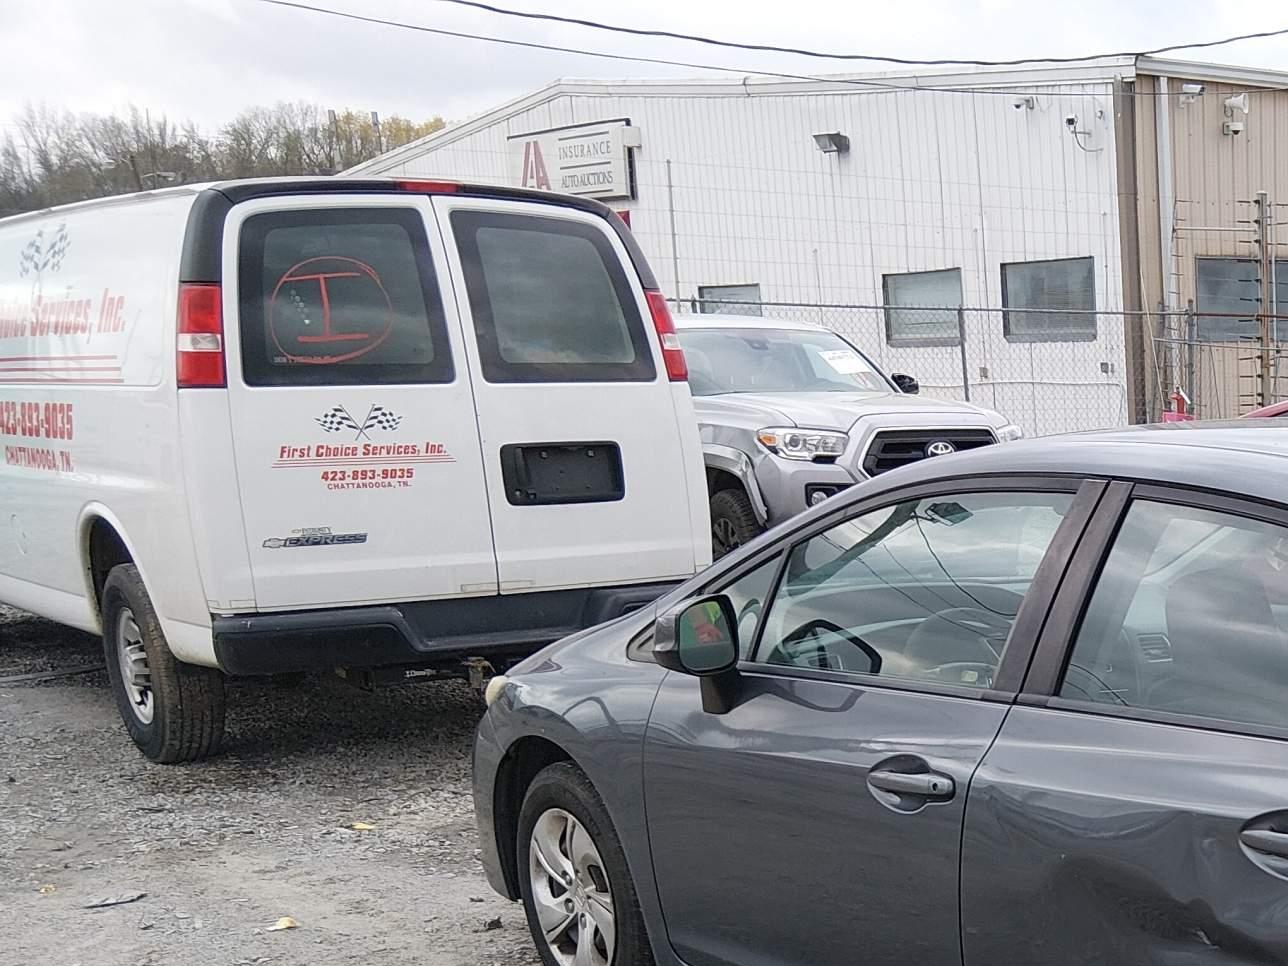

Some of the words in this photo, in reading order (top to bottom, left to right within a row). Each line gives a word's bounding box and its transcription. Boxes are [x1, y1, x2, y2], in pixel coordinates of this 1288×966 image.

[558, 141, 611, 160] INSURANCE
[561, 174, 579, 188] AUTO
[578, 171, 614, 187] AUCTIONS
[97, 287, 126, 333] Inc.
[0, 401, 73, 440] 423-893-9035
[279, 445, 311, 459] First
[315, 444, 358, 458] Choice
[363, 443, 421, 457] Services,
[425, 441, 447, 455] Inc.
[321, 468, 414, 482] 423-893-9035
[327, 482, 396, 490] CHATTANOOGA,
[286, 533, 368, 547] EXPRESS
